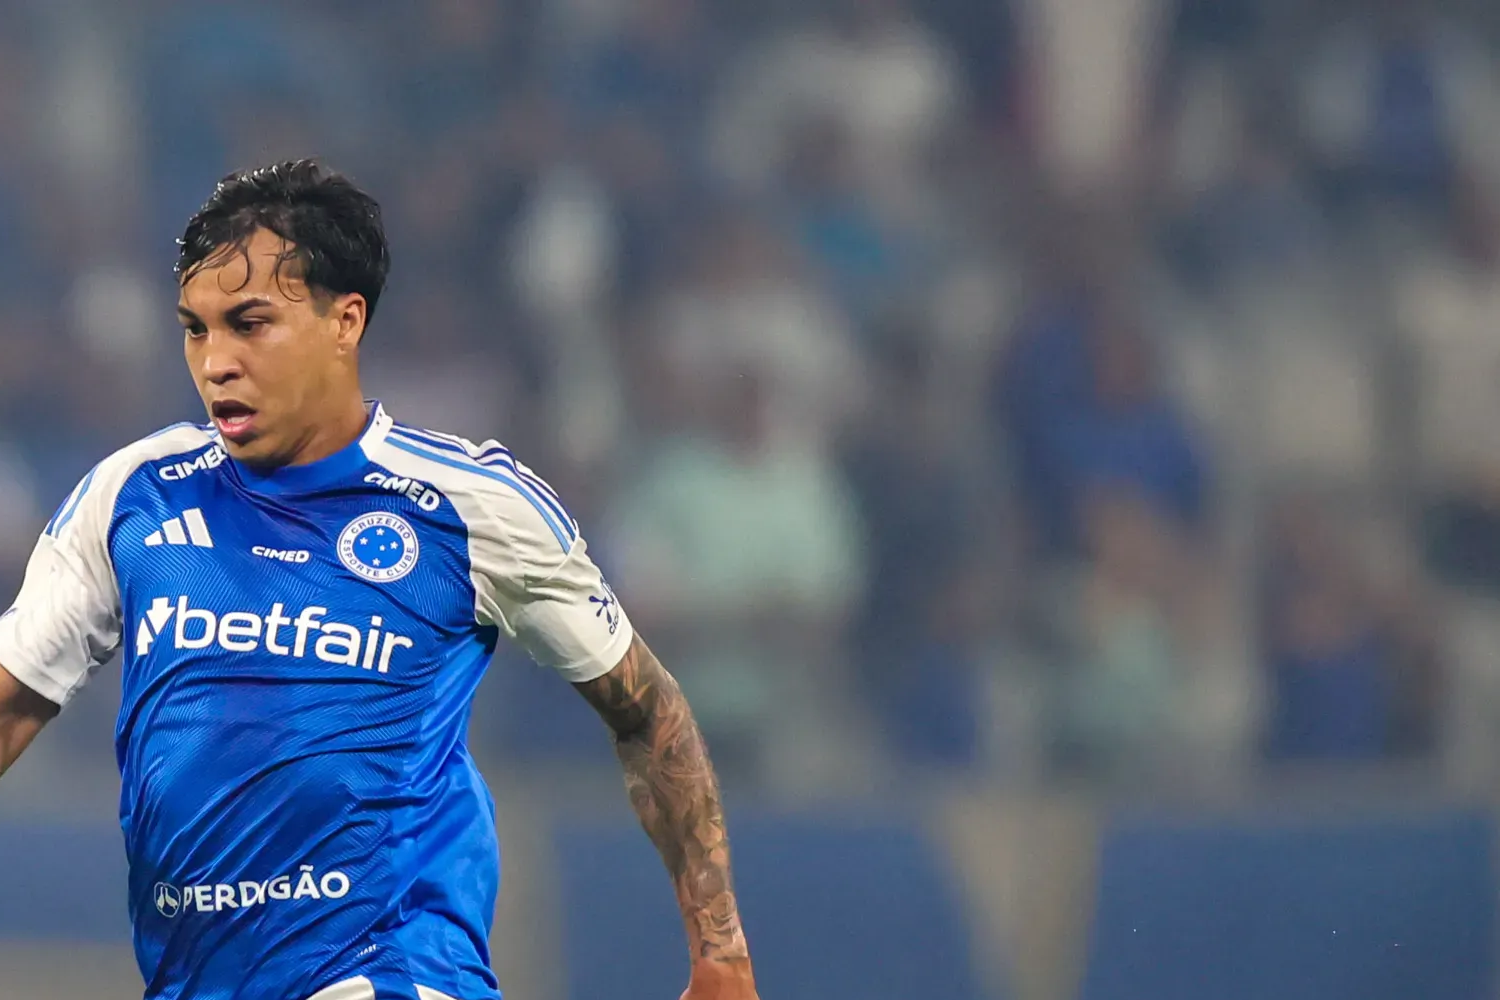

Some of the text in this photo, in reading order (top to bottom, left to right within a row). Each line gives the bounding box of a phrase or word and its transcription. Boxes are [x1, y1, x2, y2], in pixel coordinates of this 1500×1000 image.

[350, 516, 412, 540] CRUZEIRO
[251, 545, 310, 564] CIMED
[343, 538, 415, 578] ESPORTE CLUBE
[174, 595, 414, 674] betfair
[182, 864, 350, 914] PERDIGÃO
